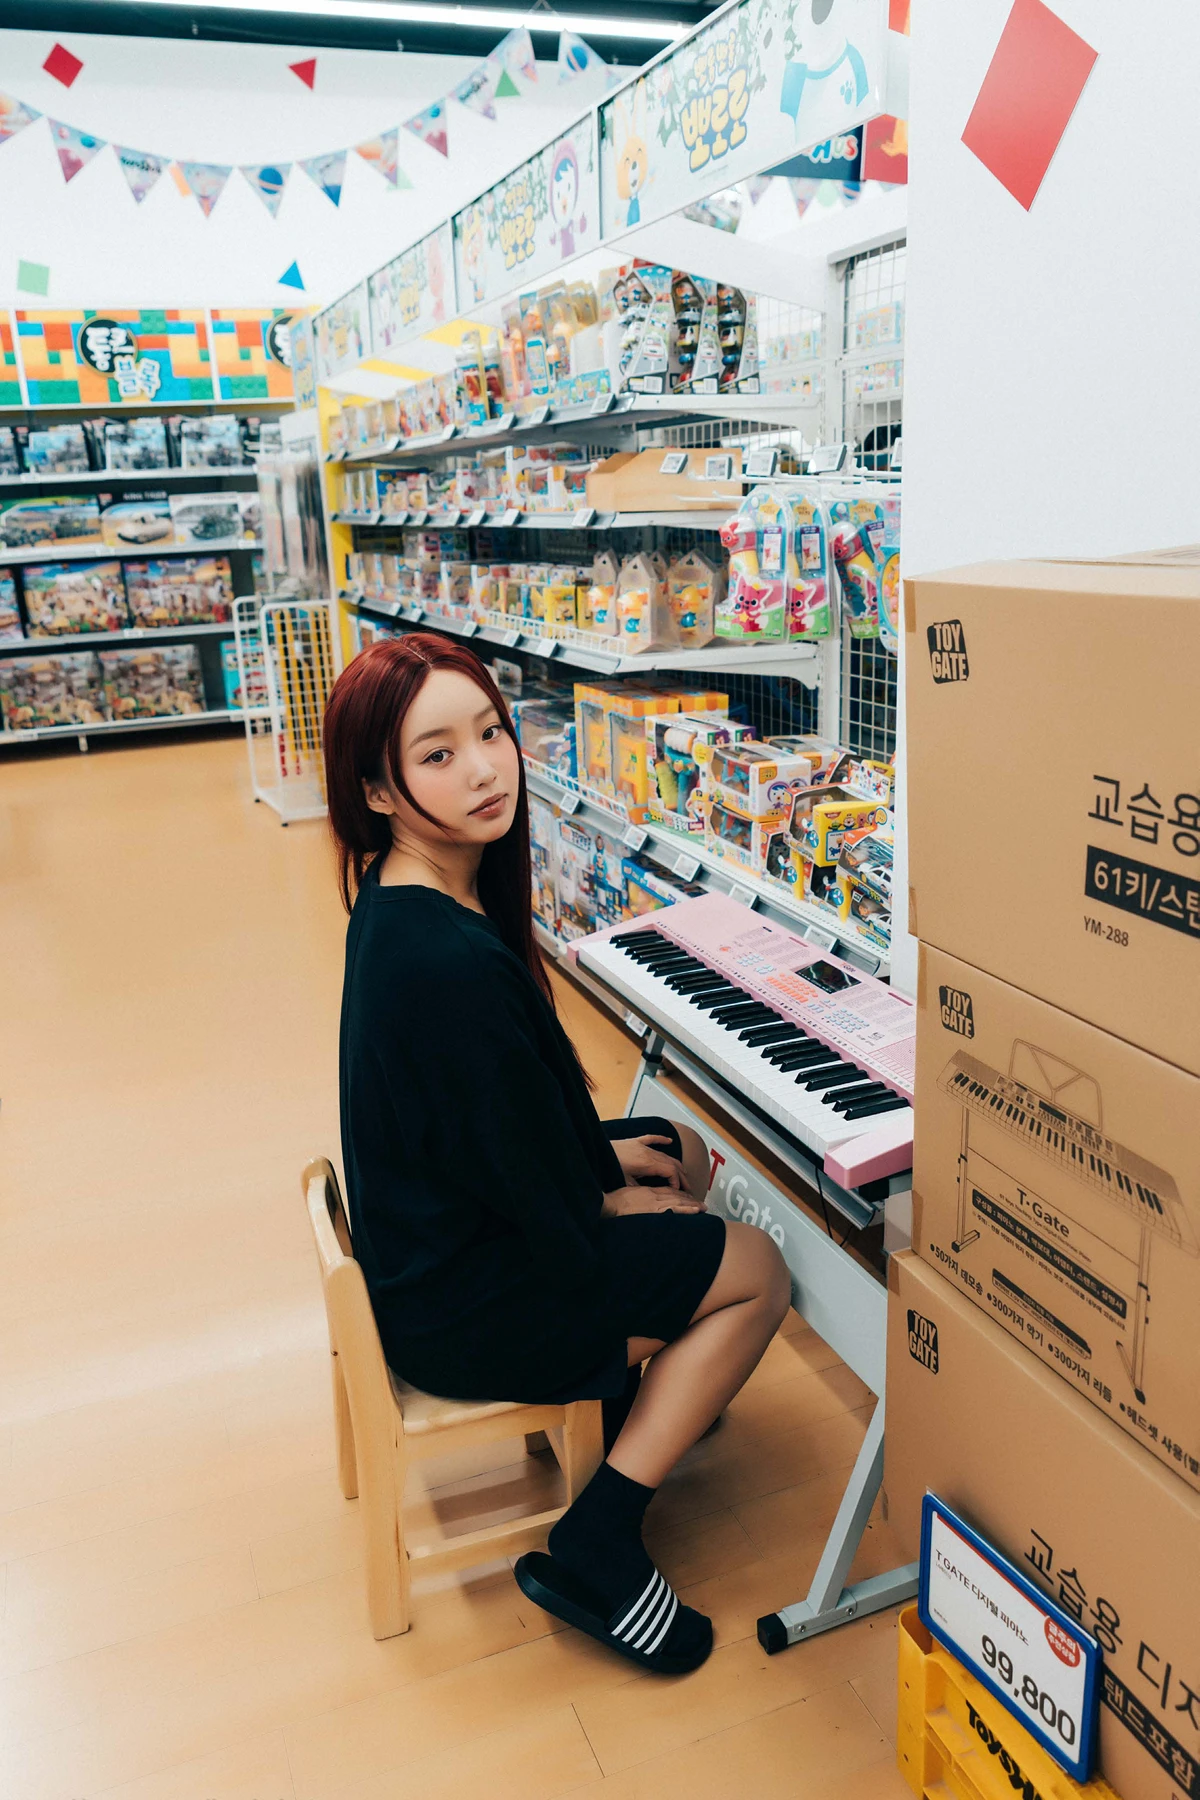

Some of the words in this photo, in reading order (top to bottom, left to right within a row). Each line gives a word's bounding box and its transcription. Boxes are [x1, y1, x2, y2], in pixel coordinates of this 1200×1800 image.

[681, 64, 749, 172] 뽀로로
[934, 623, 961, 652] TOY
[931, 651, 967, 681] GATE
[1088, 774, 1200, 857] 교습용
[1083, 915, 1129, 947] YM-288
[941, 1004, 972, 1038] GATE
[945, 987, 970, 1017] TOY
[960, 1268, 983, 1296] 데모송
[1026, 1323, 1044, 1347] 악기
[913, 1311, 937, 1348] TOY
[910, 1330, 937, 1373] GATE
[943, 1557, 970, 1590] GATE
[971, 1583, 999, 1618] 디지털
[1000, 1610, 1029, 1647] 피아노
[1024, 1527, 1123, 1655] 교습용
[981, 1634, 1076, 1746] 99,800
